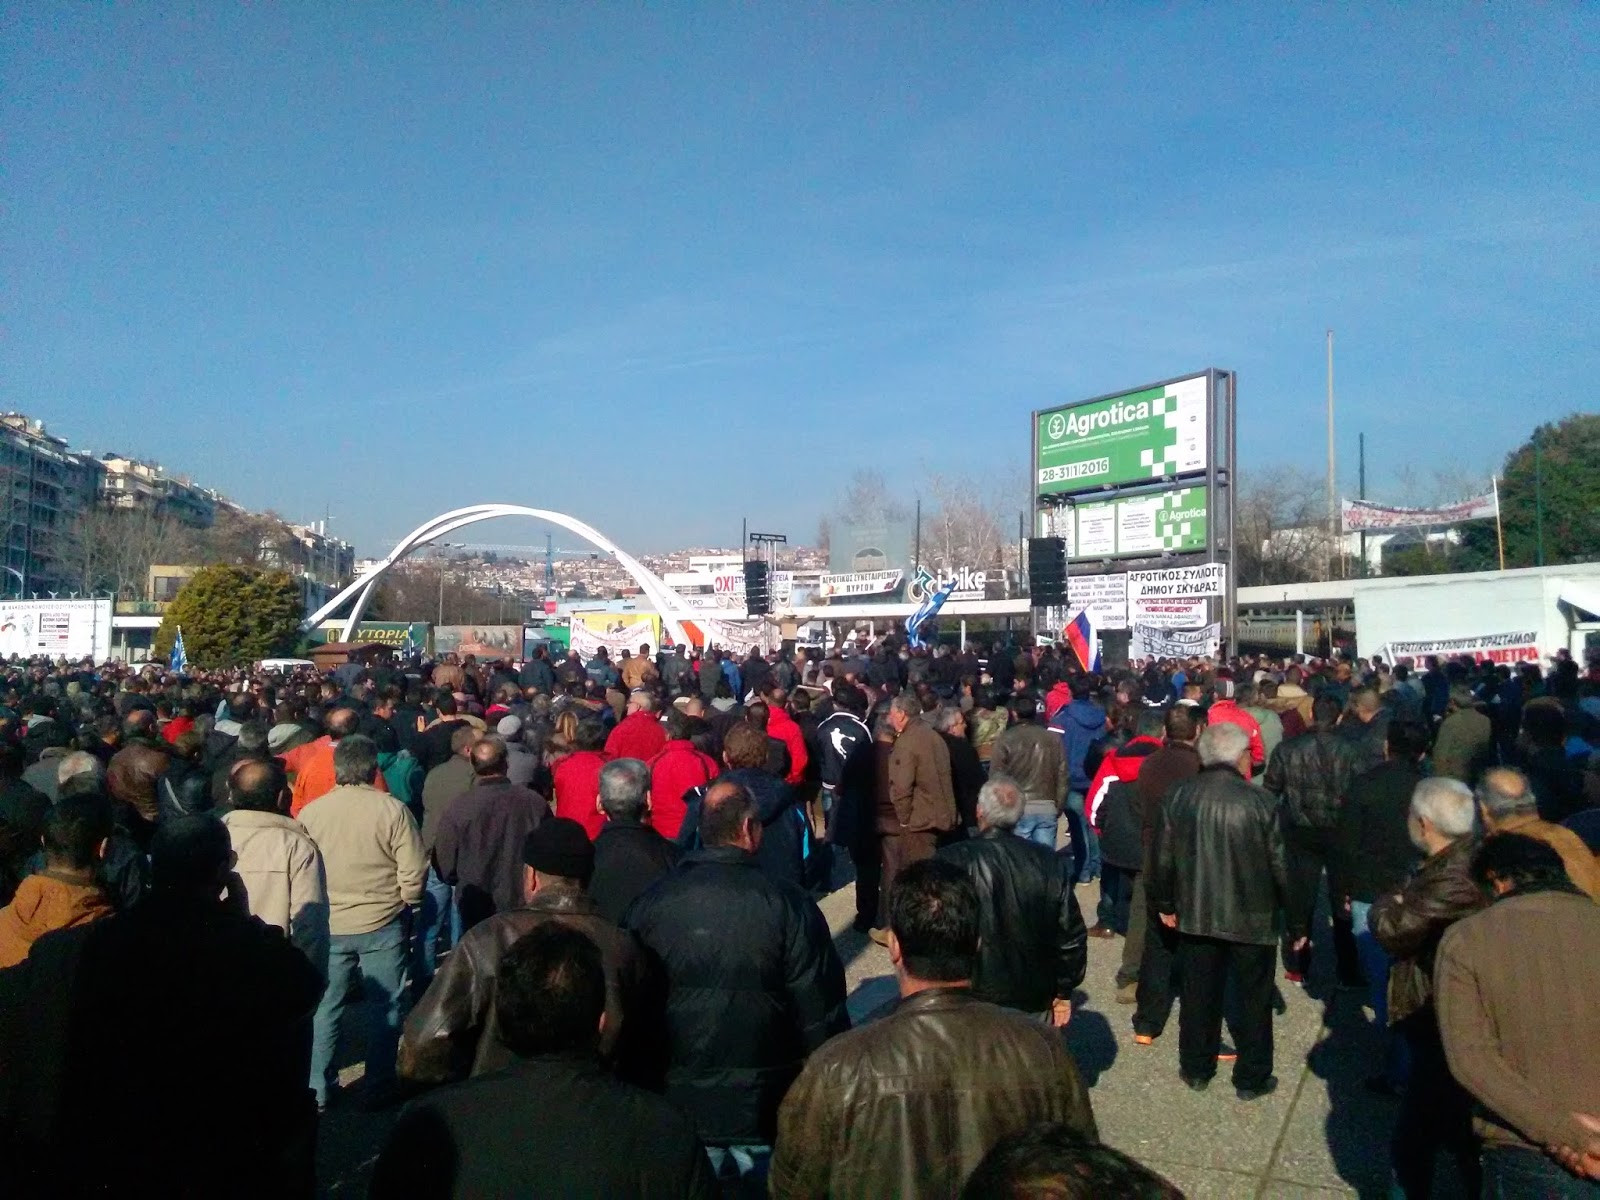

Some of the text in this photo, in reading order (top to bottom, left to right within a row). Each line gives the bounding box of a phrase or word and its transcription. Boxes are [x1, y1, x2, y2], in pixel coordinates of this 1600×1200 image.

[1066, 401, 1149, 436] Agrotica
[1169, 507, 1207, 522] Agrotica
[822, 573, 853, 584] ΑΓΡΟΤΙΚΟΣ
[937, 566, 986, 591] i-bike
[1129, 567, 1224, 582] ΑΓΡΟΤΙΚΟΣ ΣΥΛΛΟΓΟΣ
[715, 575, 735, 592] ΟΧΙ
[1140, 582, 1217, 595] ΔΗΜΟΥ ΣΚΥΔΡΑΣ
[357, 629, 409, 639] ΥΤΩΡΙΑ
[1390, 643, 1433, 654] ΑΓΡΟΤΙΚΟΣ
[1436, 638, 1477, 651] ΣΥΛΛΟΓΟΣ
[1488, 646, 1539, 664] ΜΕΤΡΑ
